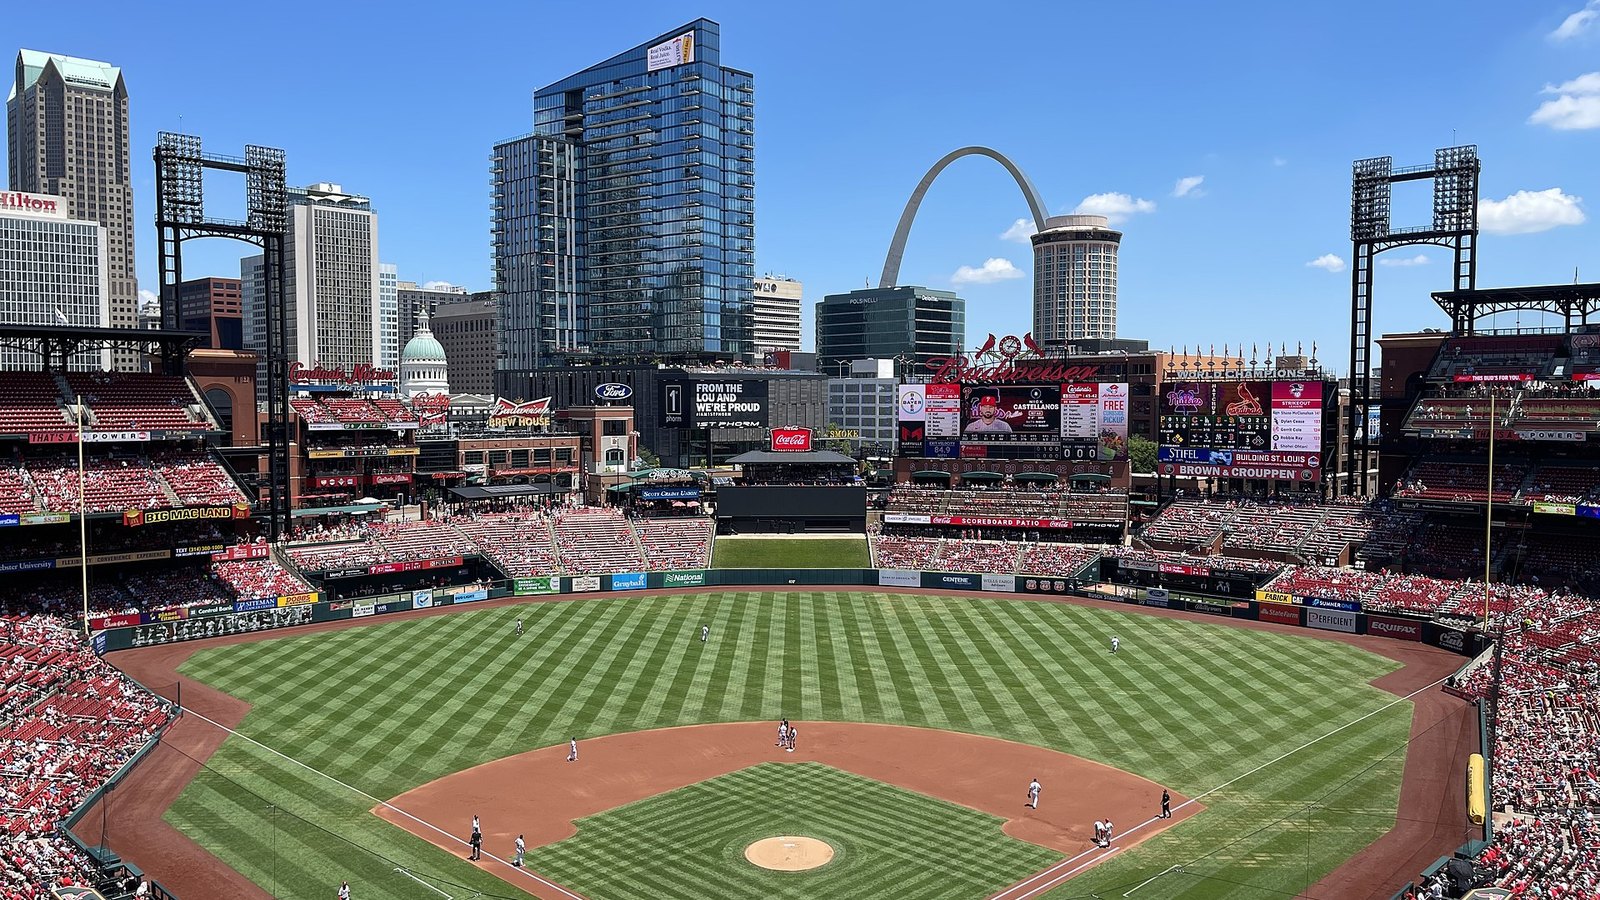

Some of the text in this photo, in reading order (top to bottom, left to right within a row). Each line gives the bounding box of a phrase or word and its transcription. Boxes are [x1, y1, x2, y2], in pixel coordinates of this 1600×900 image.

[849, 297, 878, 305] POLSINELLI
[288, 362, 395, 385] Cardinals Nation
[926, 354, 1100, 384] Budweiser
[1177, 369, 1307, 380] WORLD CHAMPIONS
[602, 385, 626, 398] Ford
[696, 384, 742, 393] FROM THE
[1067, 384, 1092, 394] Cardinals
[696, 394, 736, 403] LOU AND
[494, 403, 548, 417] Budweiser
[696, 403, 760, 412] WE'RE PROUD
[1103, 400, 1124, 411] FREE
[489, 416, 550, 428] BREW HOUSE
[666, 415, 682, 423] phorm
[1103, 416, 1124, 424] PICKUP
[32, 433, 73, 442] THAT'S A
[830, 430, 859, 438] SMOKE
[776, 434, 806, 445] Coca-Cola
[934, 446, 951, 454] 84.9
[1064, 449, 1095, 458] 0 0 0
[1169, 448, 1198, 459] STIFEL
[1236, 453, 1305, 463] BUILDING ST. LOUIS
[1179, 465, 1220, 476] BROWN
[1232, 467, 1295, 479] CROUPPEN
[144, 507, 231, 524] BIG MAC LAND
[962, 518, 1013, 526] SCOREBOARD
[19, 561, 52, 569] University
[61, 558, 91, 566] FLEXIBITY
[97, 555, 131, 563] CONVENIENCE
[674, 574, 702, 582] National
[246, 598, 275, 606] SITEMAN
[1087, 592, 1124, 602] BUSCH STADIUM
[1264, 593, 1304, 604] FABICK CAT
[158, 610, 177, 619] planet
[198, 604, 233, 615] Central Bank
[1309, 611, 1353, 627] PERFICIENT
[1371, 621, 1417, 634] EQUIFAX
[1439, 632, 1464, 648] Club
